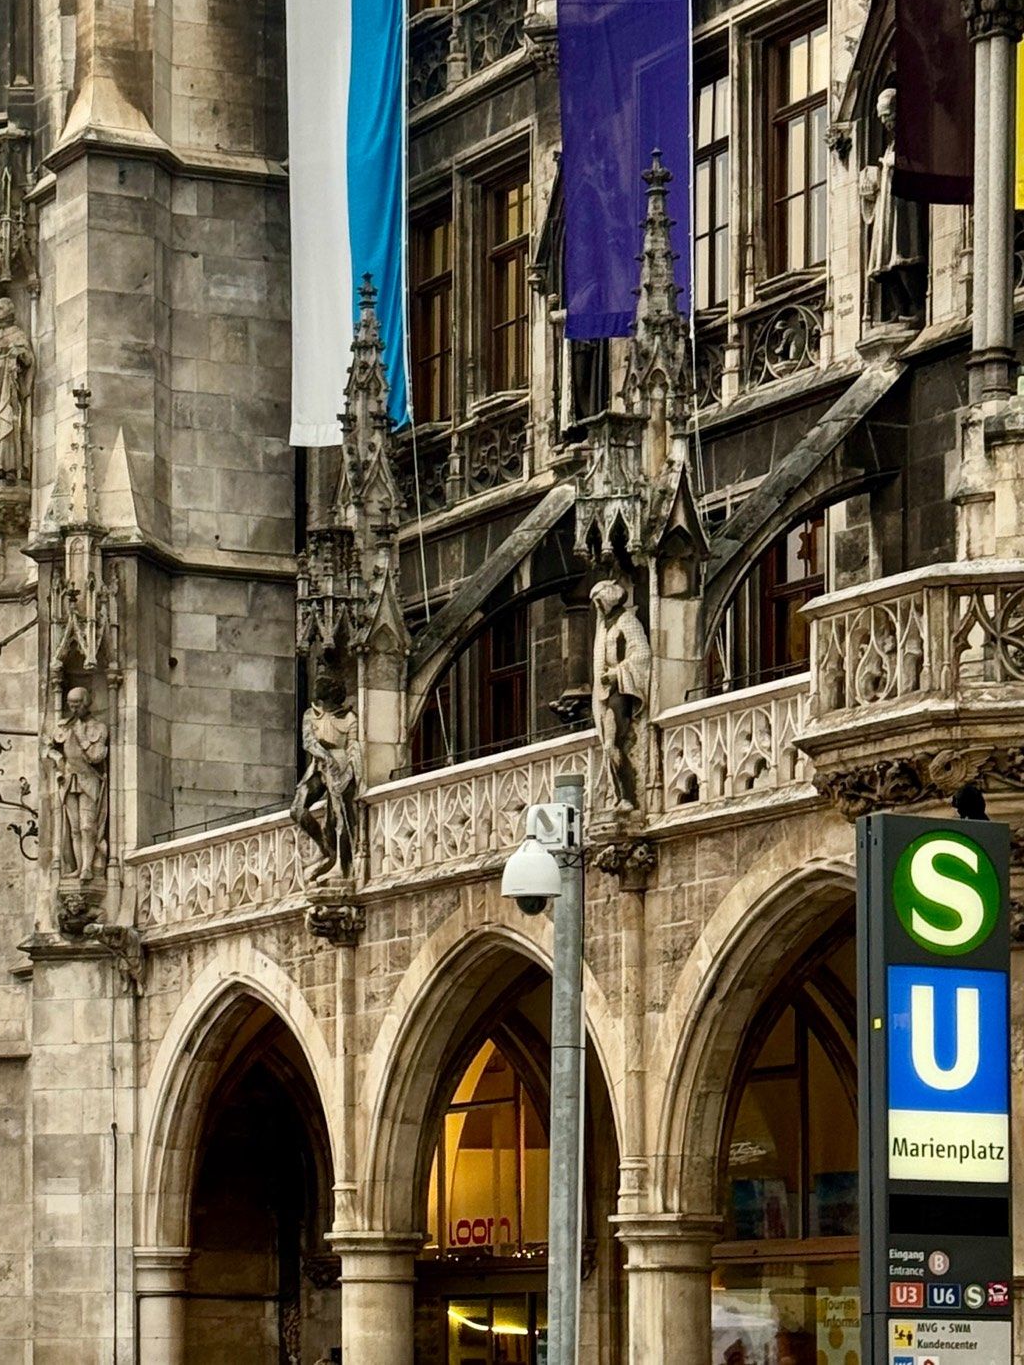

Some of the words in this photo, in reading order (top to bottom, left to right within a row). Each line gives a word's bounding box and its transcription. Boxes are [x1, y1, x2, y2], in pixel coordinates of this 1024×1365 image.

[911, 839, 984, 947] S
[911, 984, 980, 1091] U
[891, 1136, 1005, 1162] Marienplatz
[889, 1249, 924, 1262] Eingang
[934, 1254, 944, 1271] B
[889, 1265, 924, 1276] Entrance
[895, 1286, 917, 1303] U3
[933, 1288, 955, 1304] U6
[967, 1286, 982, 1306] S
[823, 1314, 860, 1327] Informa
[917, 1323, 937, 1333] MVG
[949, 1323, 971, 1333] SWM
[917, 1339, 978, 1350] Kundencenter
